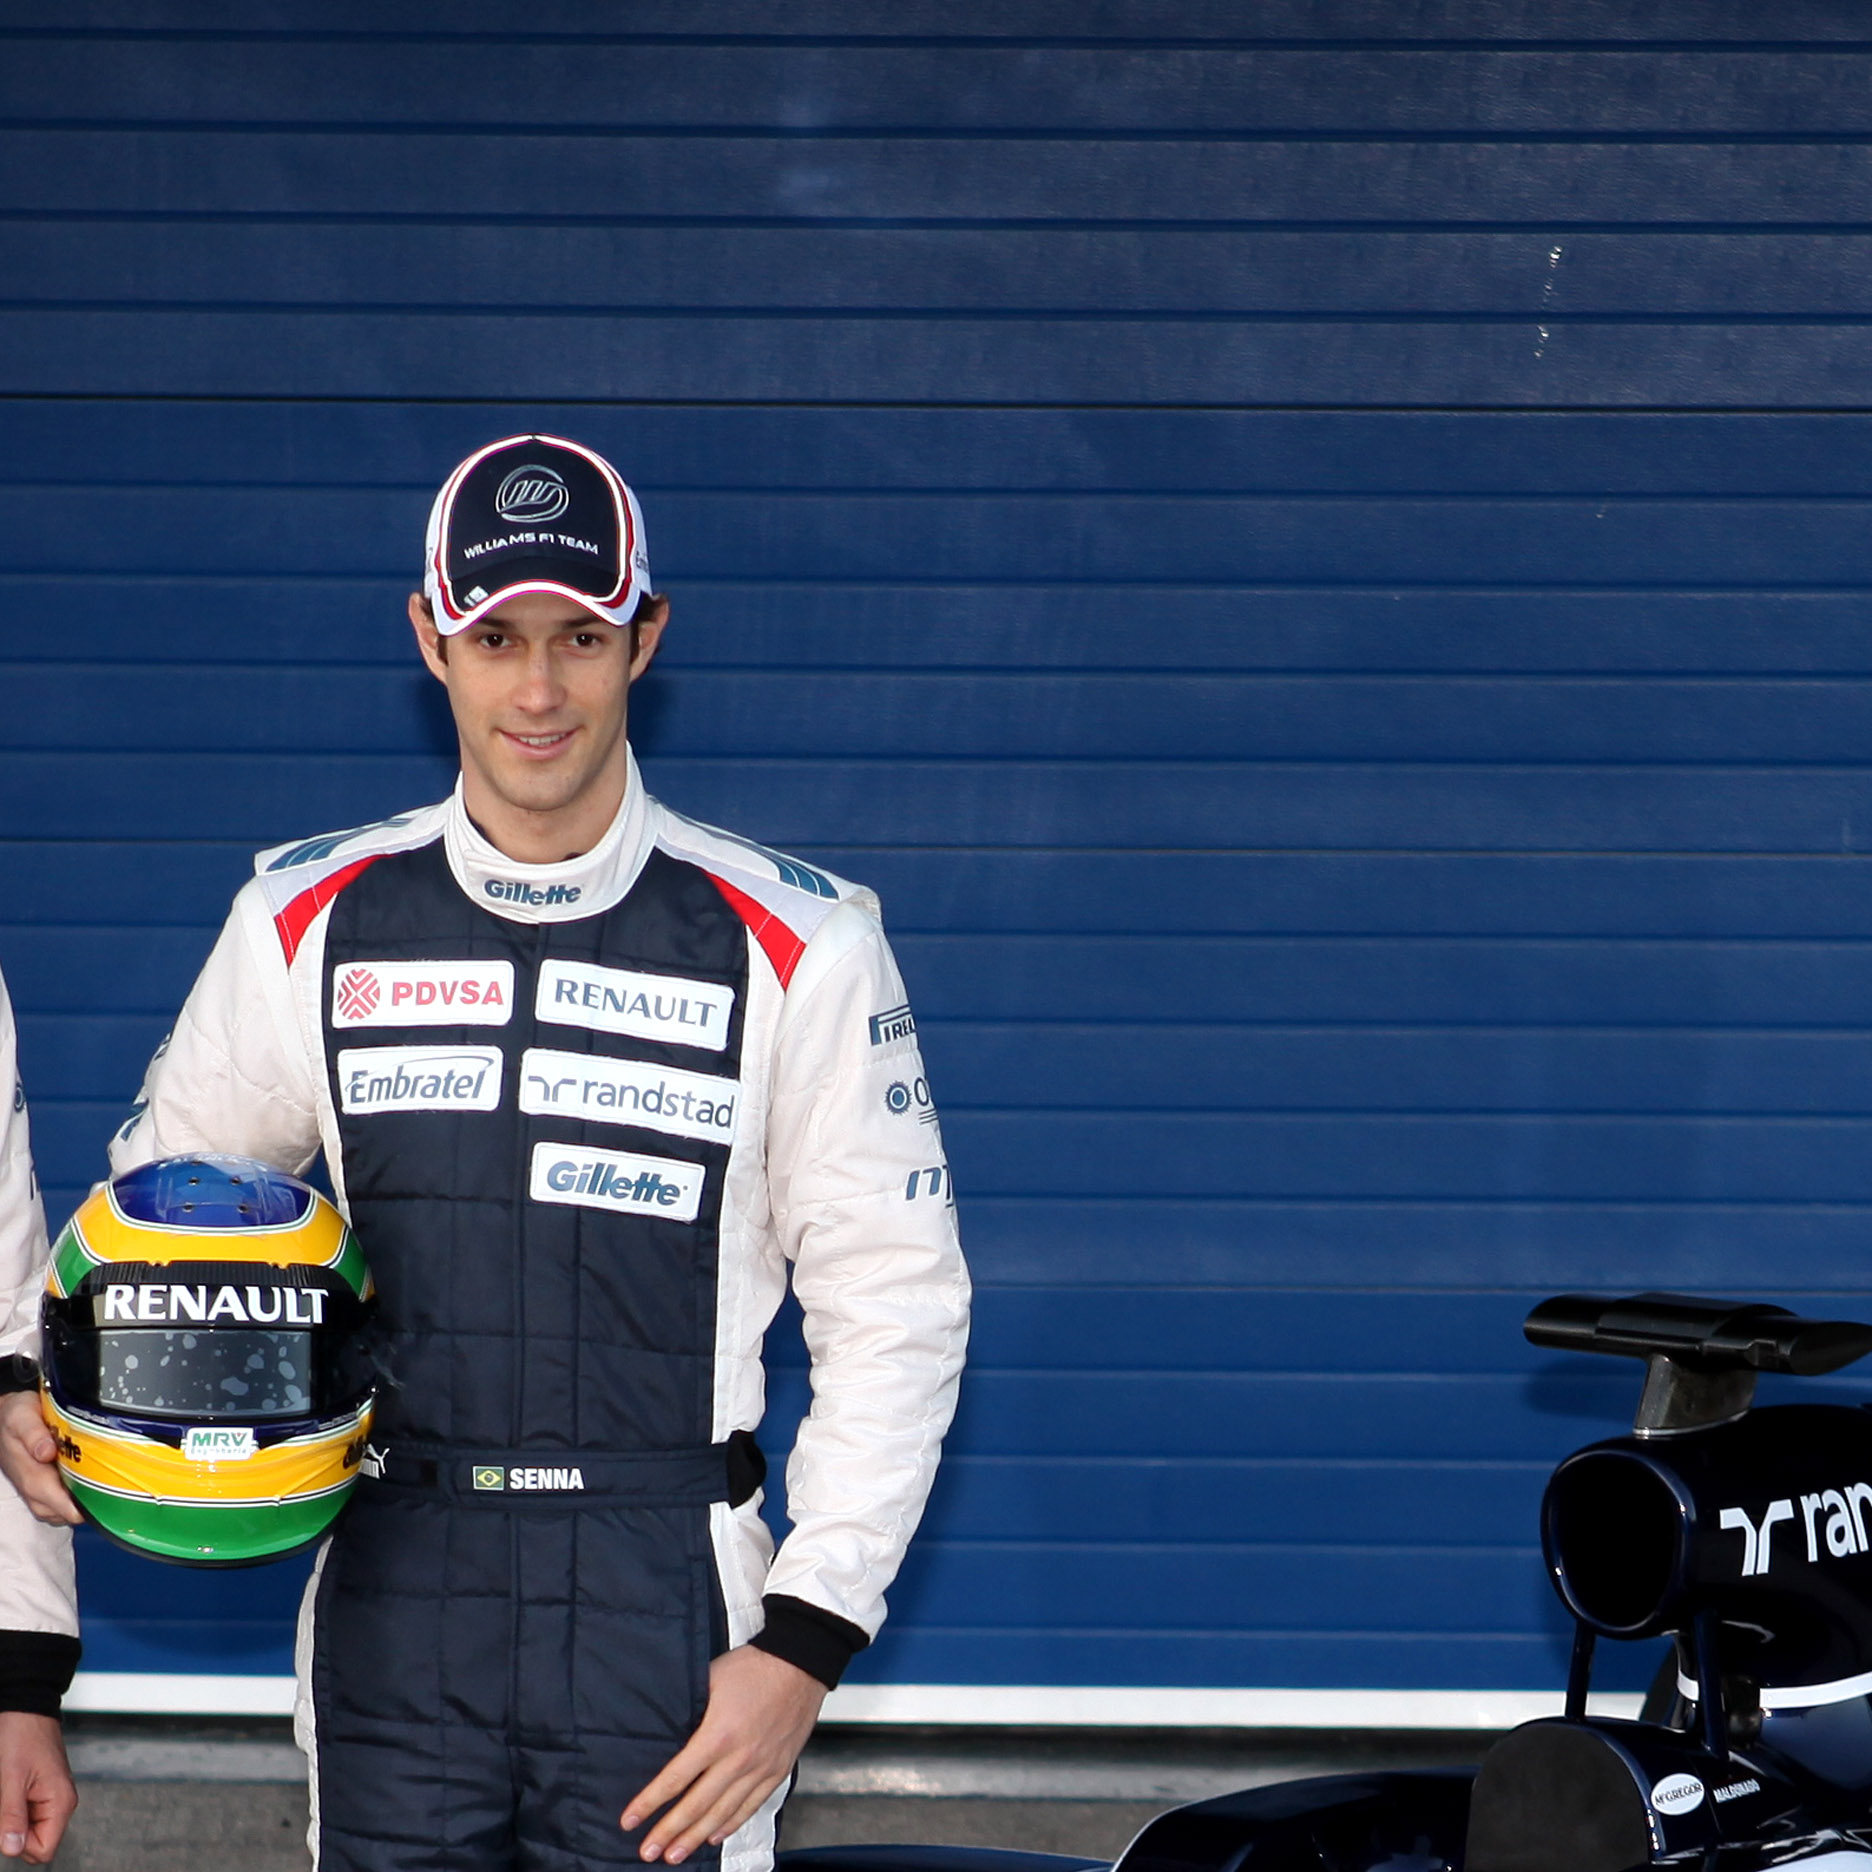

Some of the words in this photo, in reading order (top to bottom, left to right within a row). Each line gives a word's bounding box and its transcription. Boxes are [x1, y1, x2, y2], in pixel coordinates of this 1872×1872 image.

[463, 532, 535, 559] WILLIAMS
[539, 532, 554, 543] F1
[558, 534, 599, 555] TEAM
[484, 878, 582, 906] Gillette
[391, 979, 505, 1008] PDVSA
[555, 978, 718, 1027] RENAULT
[344, 1055, 495, 1105] Embratel
[581, 1080, 736, 1129] randstad
[545, 1160, 682, 1207] Gillette
[105, 1285, 328, 1325] RENAULT
[192, 1431, 247, 1447] MRV
[509, 1467, 585, 1491] SENNA
